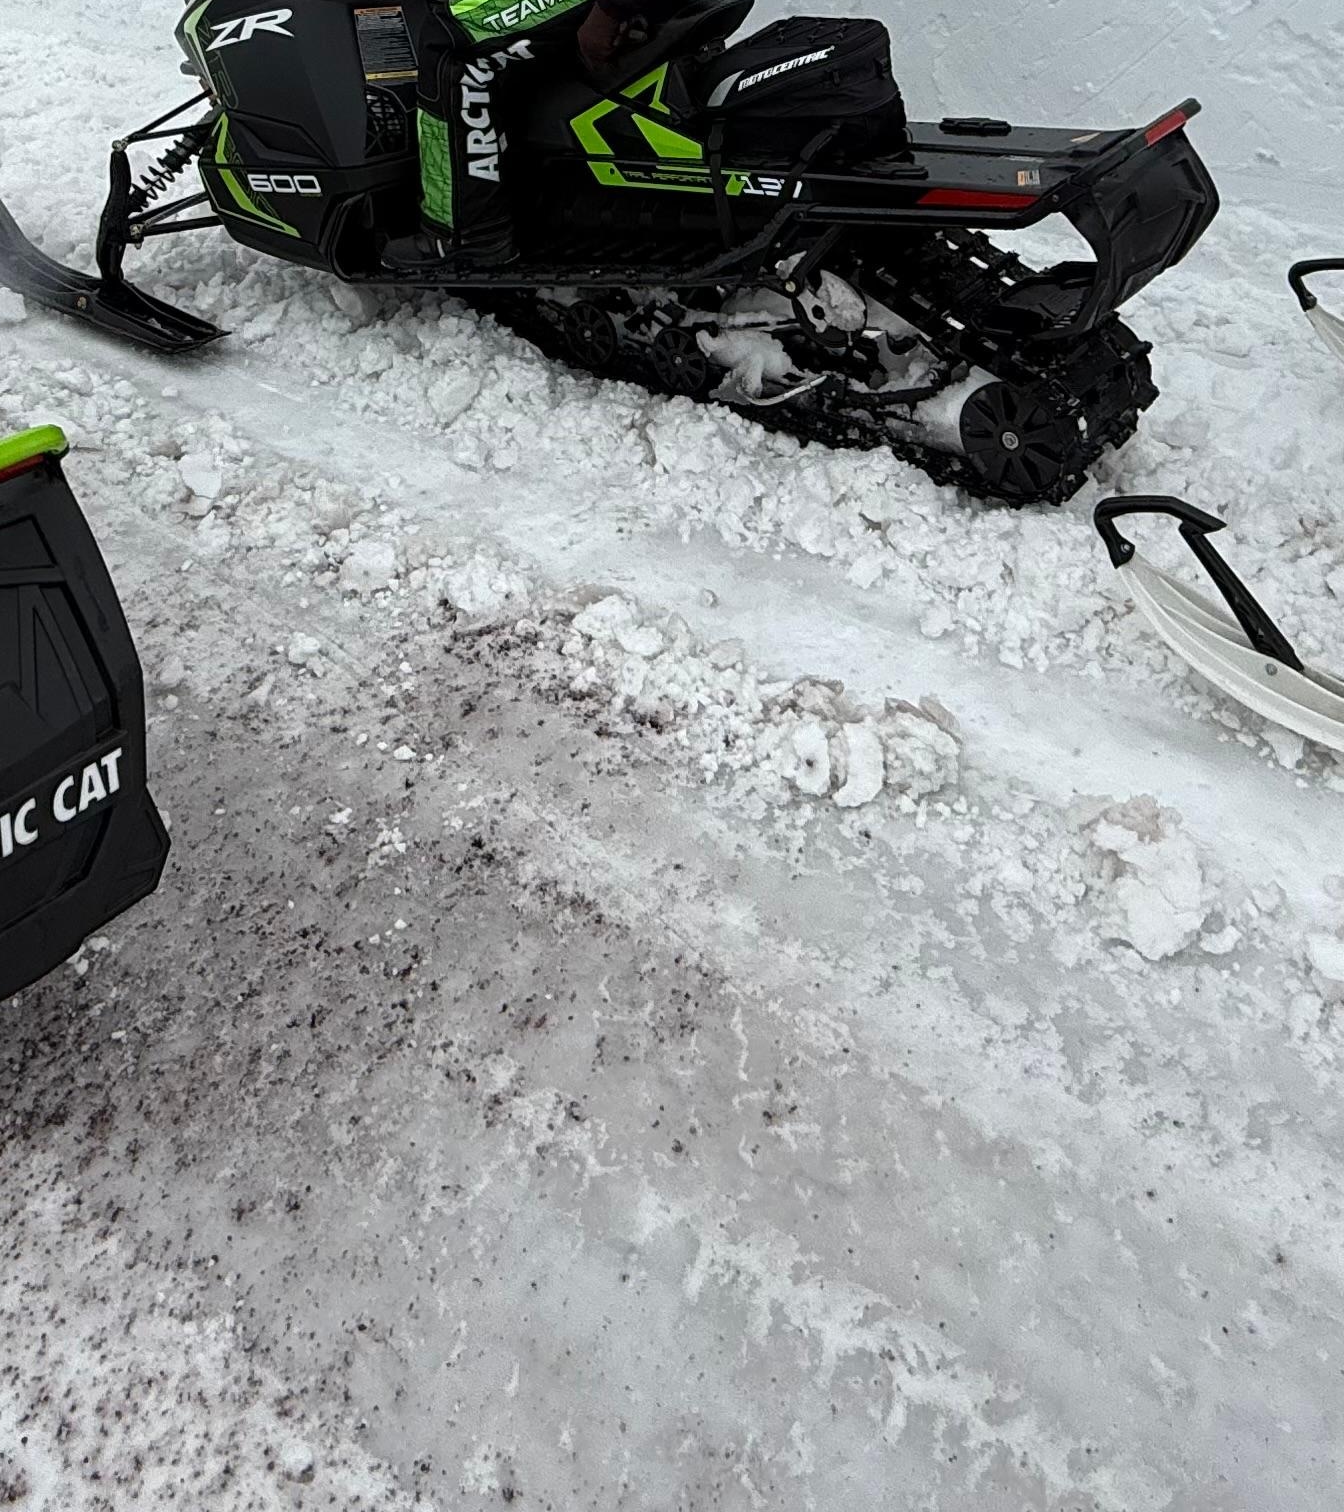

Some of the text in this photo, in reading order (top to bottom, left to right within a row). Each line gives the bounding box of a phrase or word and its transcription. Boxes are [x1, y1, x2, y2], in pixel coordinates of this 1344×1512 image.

[205, 8, 295, 52] ZR
[247, 174, 322, 193] 600
[52, 746, 122, 823] CAT
